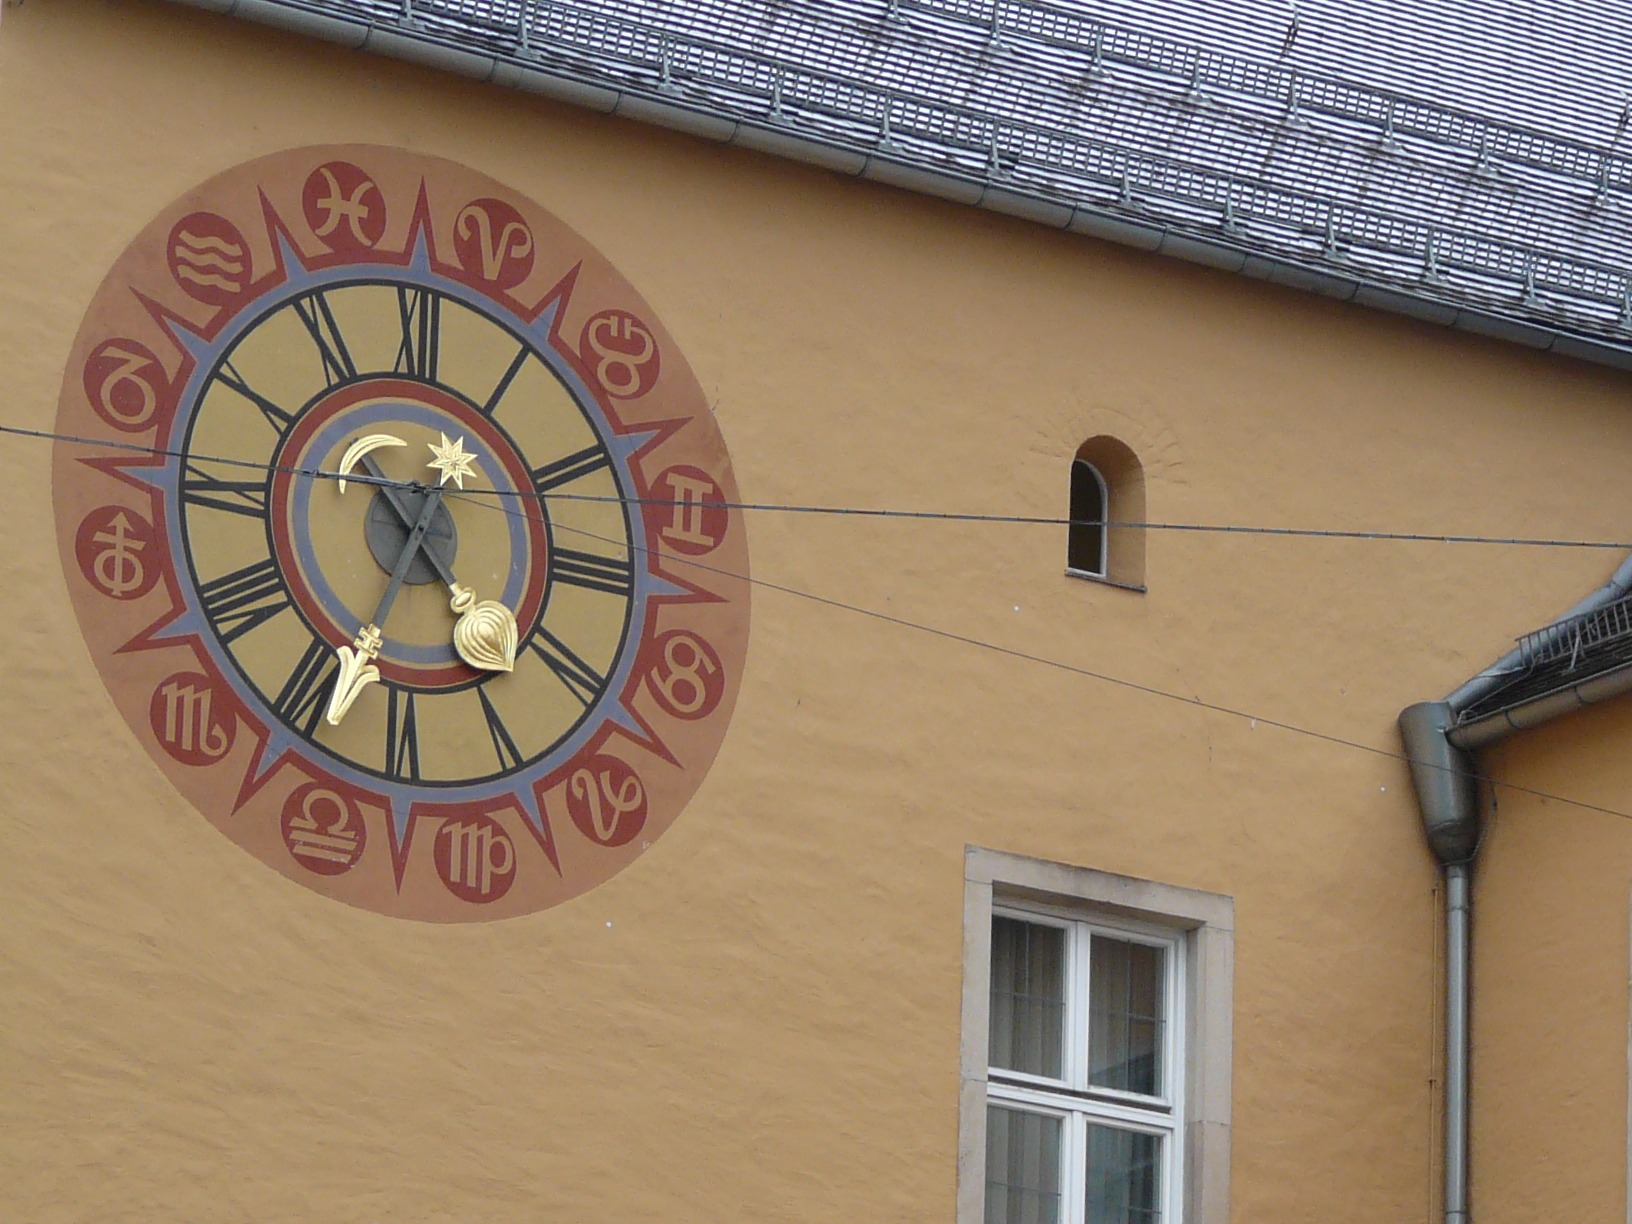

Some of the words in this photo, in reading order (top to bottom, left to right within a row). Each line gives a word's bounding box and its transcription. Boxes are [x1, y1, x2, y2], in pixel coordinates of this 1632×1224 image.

[291, 290, 358, 386] XI
[393, 286, 441, 381] XII
[214, 357, 295, 435] X
[482, 345, 532, 416] I
[184, 463, 267, 519] IX
[531, 443, 608, 493] II
[200, 558, 293, 646] VIII
[551, 547, 631, 597] III
[528, 624, 606, 708] IV
[385, 686, 421, 781] VI
[477, 685, 525, 771] V
